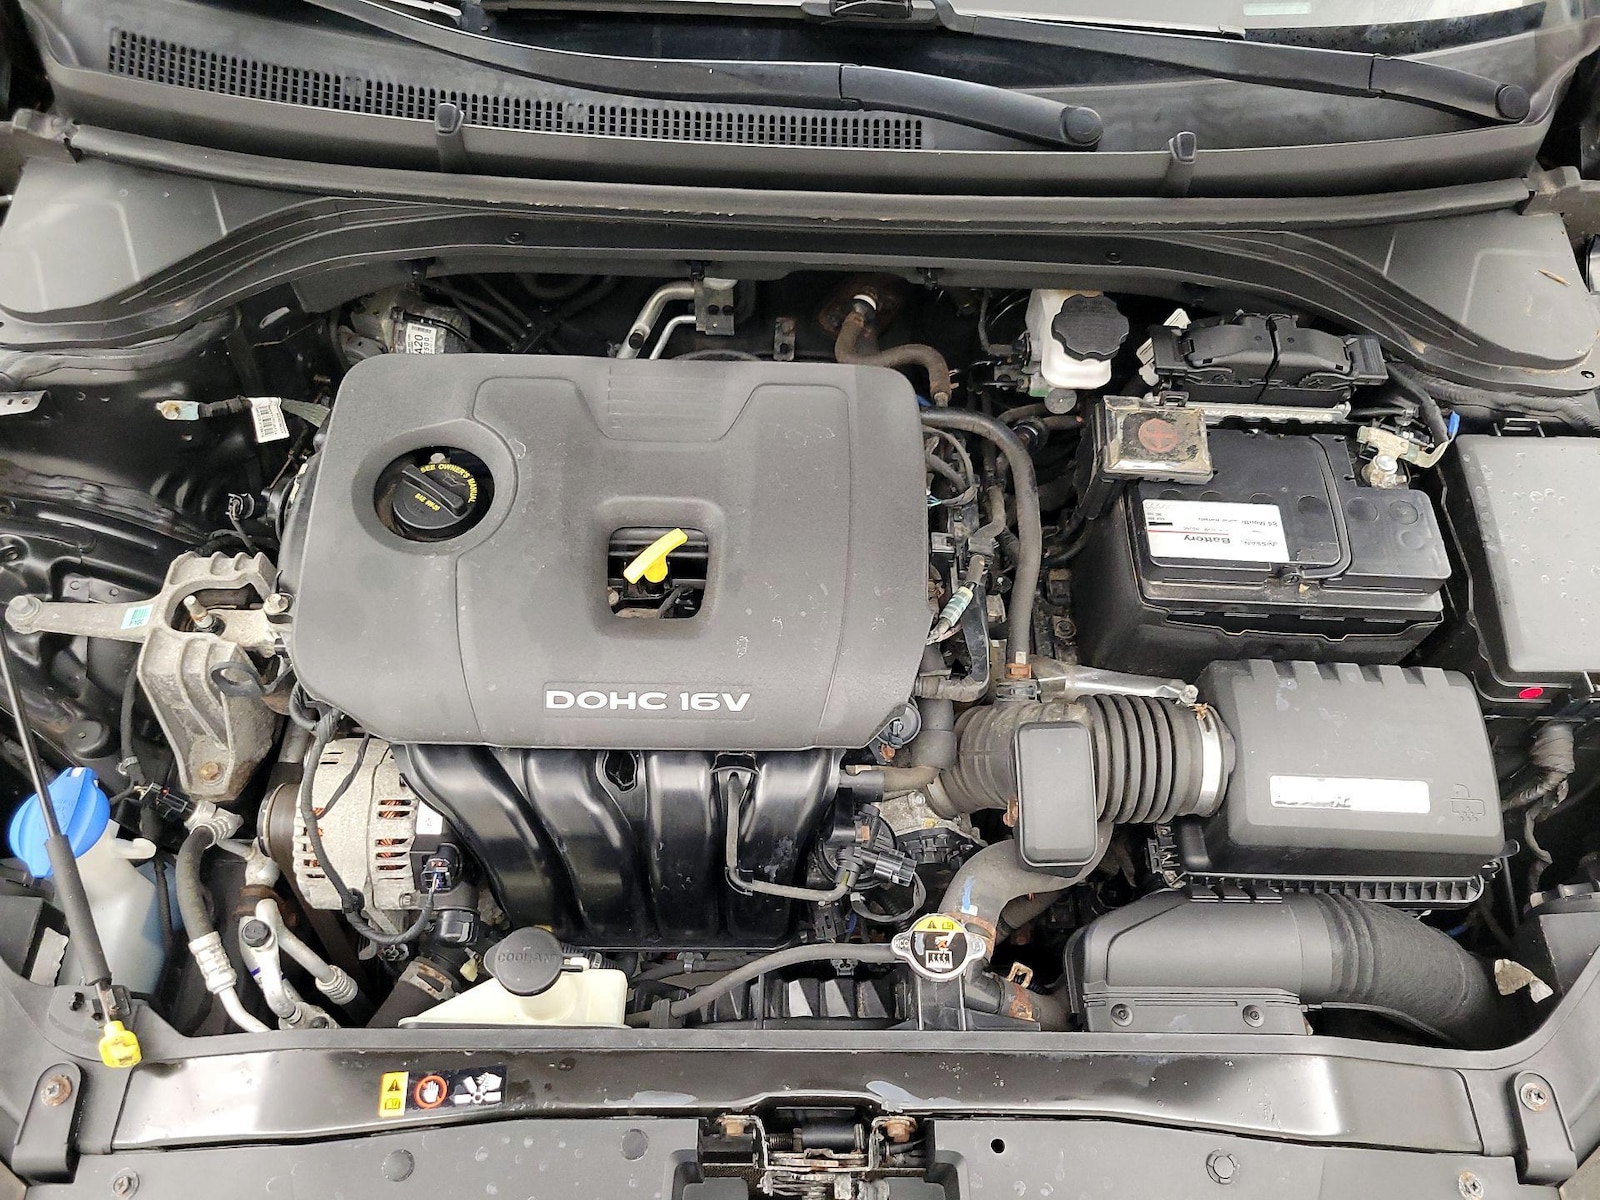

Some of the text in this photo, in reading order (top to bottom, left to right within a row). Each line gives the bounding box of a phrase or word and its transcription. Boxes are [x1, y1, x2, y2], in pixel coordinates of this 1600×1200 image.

[420, 463, 478, 503] SEE OWNER'S MANUAL
[1183, 534, 1231, 544] Battery
[545, 690, 751, 713] DOHC 16V
[498, 952, 561, 965] COOLANT
